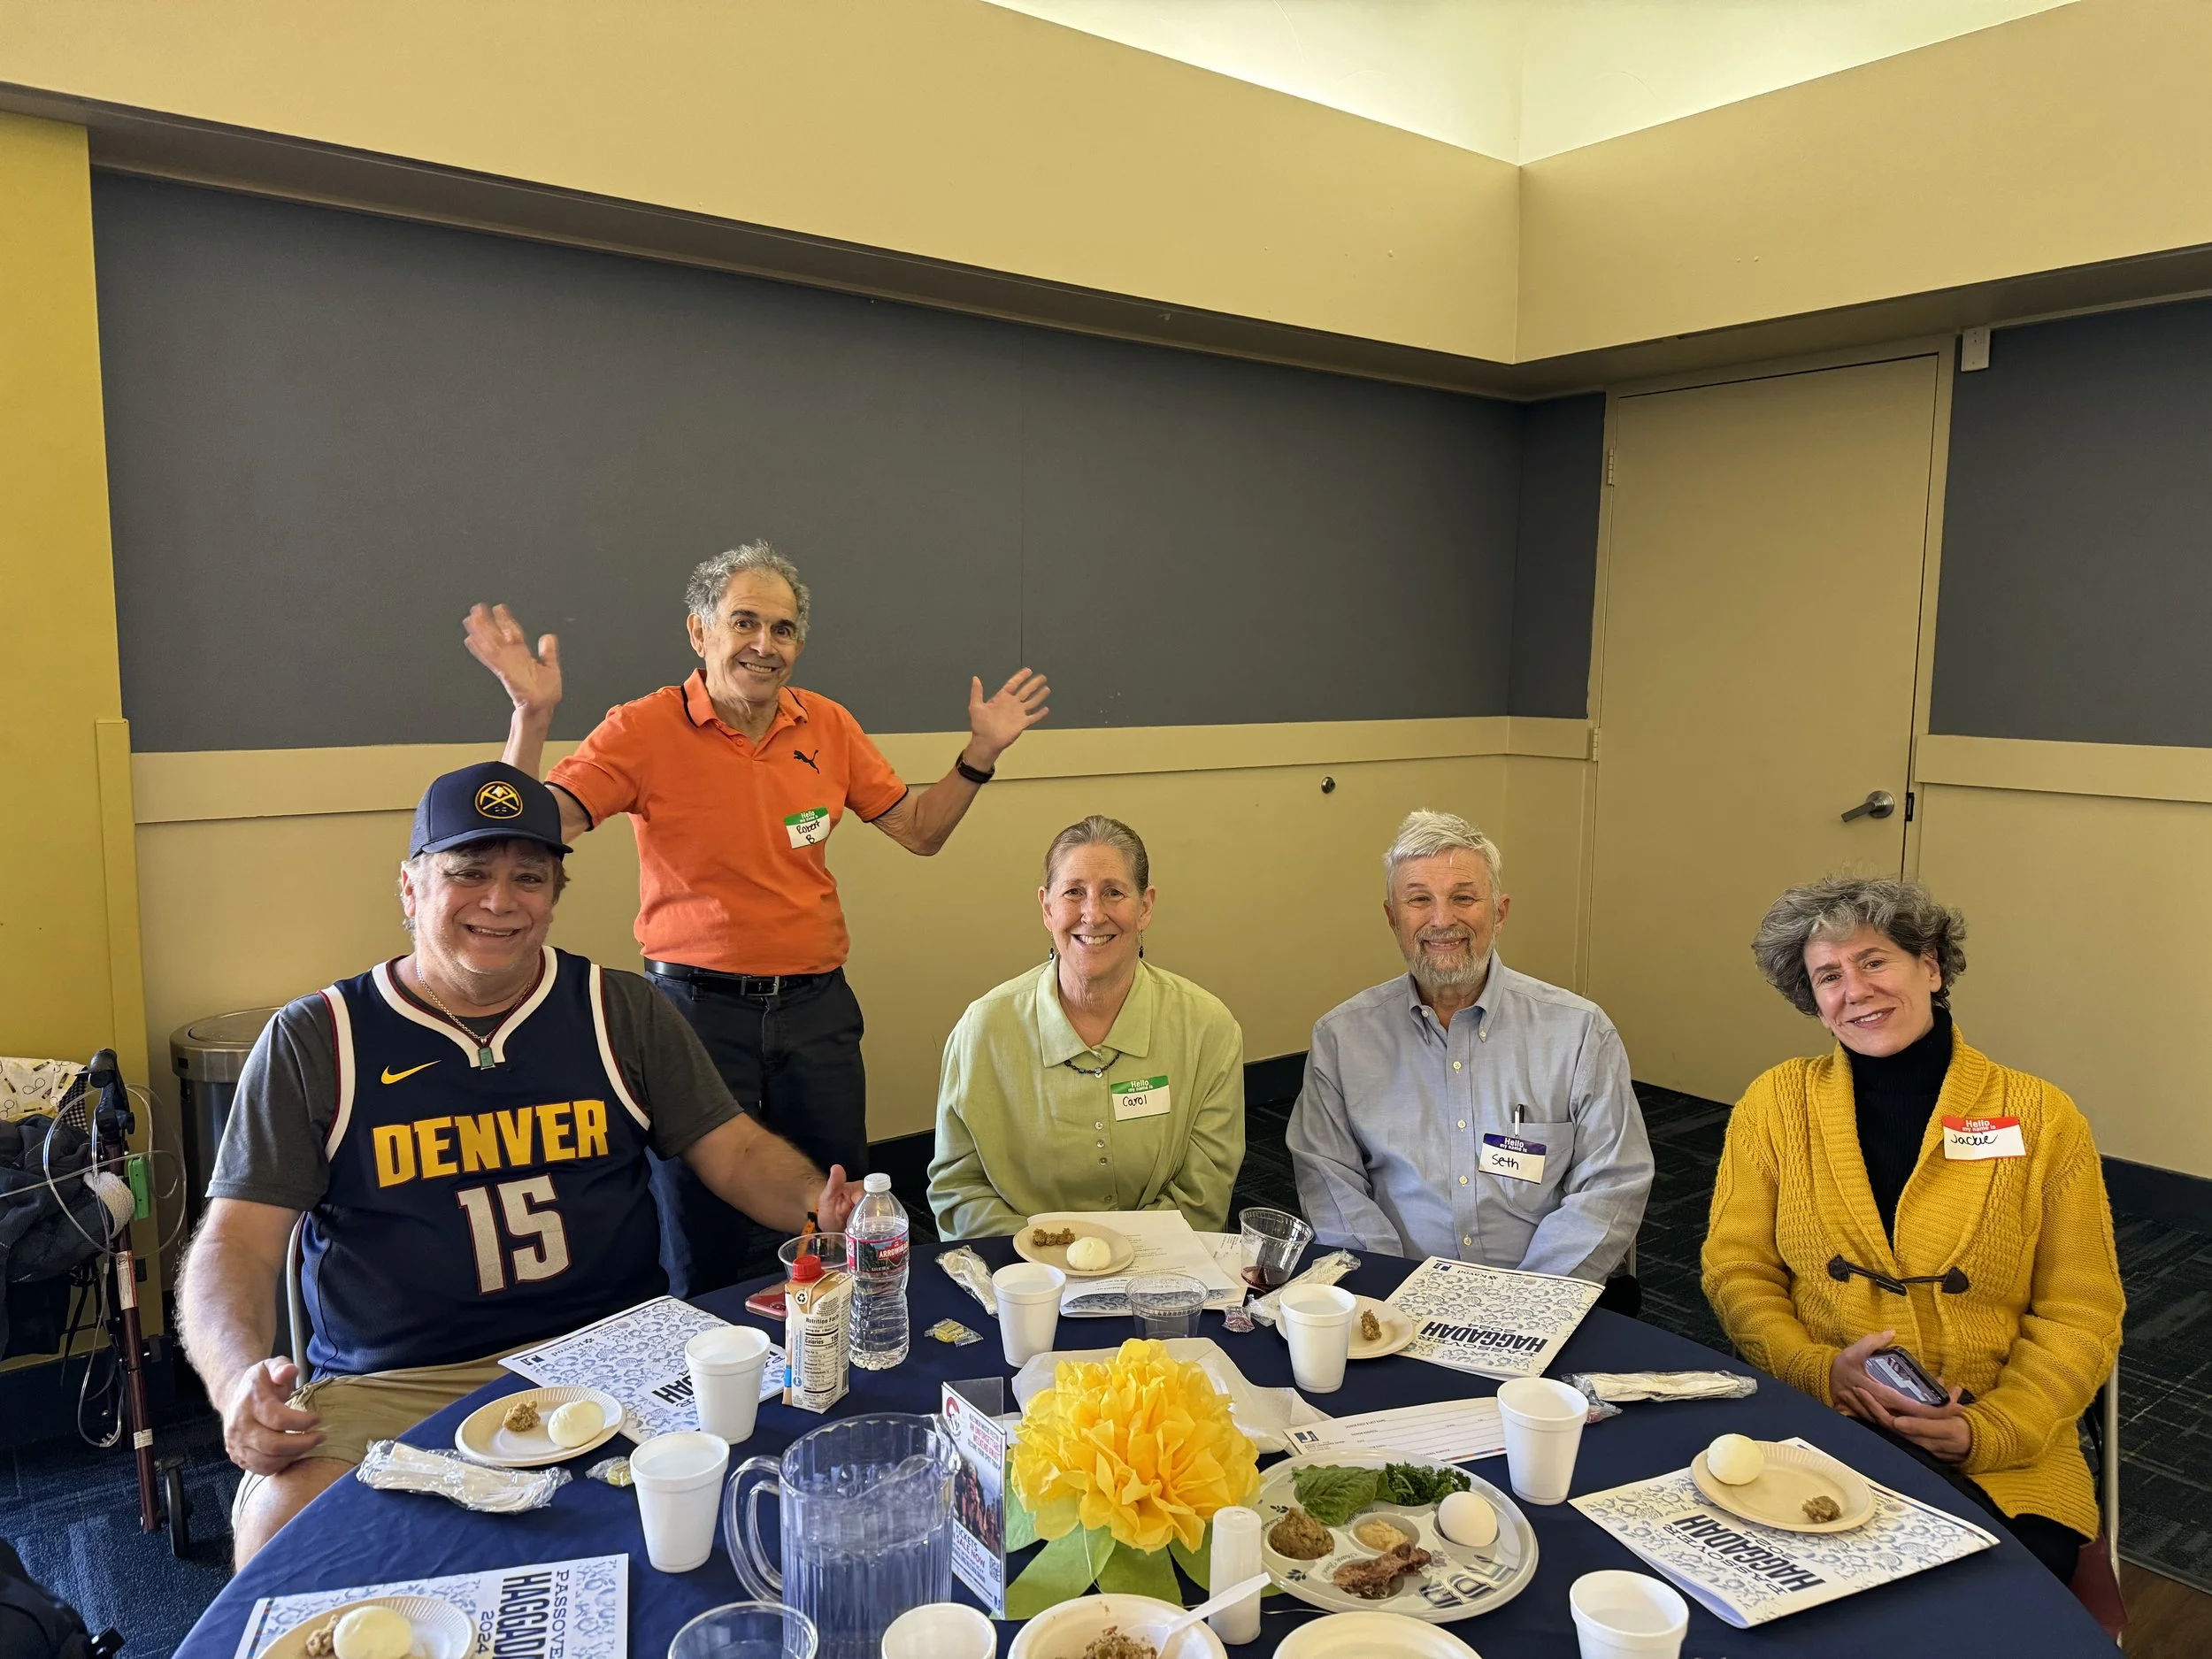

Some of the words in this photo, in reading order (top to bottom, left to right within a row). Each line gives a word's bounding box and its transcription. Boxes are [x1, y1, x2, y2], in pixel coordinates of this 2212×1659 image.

[796, 820, 820, 834] Robert
[805, 834, 816, 844] B
[1131, 1079, 1149, 1088] Hello
[1122, 1094, 1148, 1107] Carol
[373, 1099, 609, 1187] DENVER
[1504, 1138, 1524, 1148] Hello
[1950, 1132, 1998, 1146] Jackie
[1492, 1154, 1519, 1171] Seth
[455, 1174, 572, 1295] 15
[1457, 1270, 1487, 1279] Kavod
[1420, 1321, 1548, 1353] HAGGADAH
[1467, 1324, 1517, 1334] 2024
[551, 1341, 584, 1357] Kavod
[1417, 1334, 1537, 1357] PASSOVER
[975, 1425, 1000, 1452] UNFORGETTABL
[955, 1524, 979, 1552] TICKETS
[1744, 1531, 1798, 1559] 2024
[956, 1536, 971, 1555] SALE
[971, 1549, 986, 1568] NOW
[1664, 1524, 1787, 1595] PASSOVER
[1672, 1515, 1826, 1592] HAGGADAH
[492, 1571, 552, 1659] HAGGAD
[550, 1570, 570, 1659] PASSOVE
[476, 1610, 495, 1654] 2024
